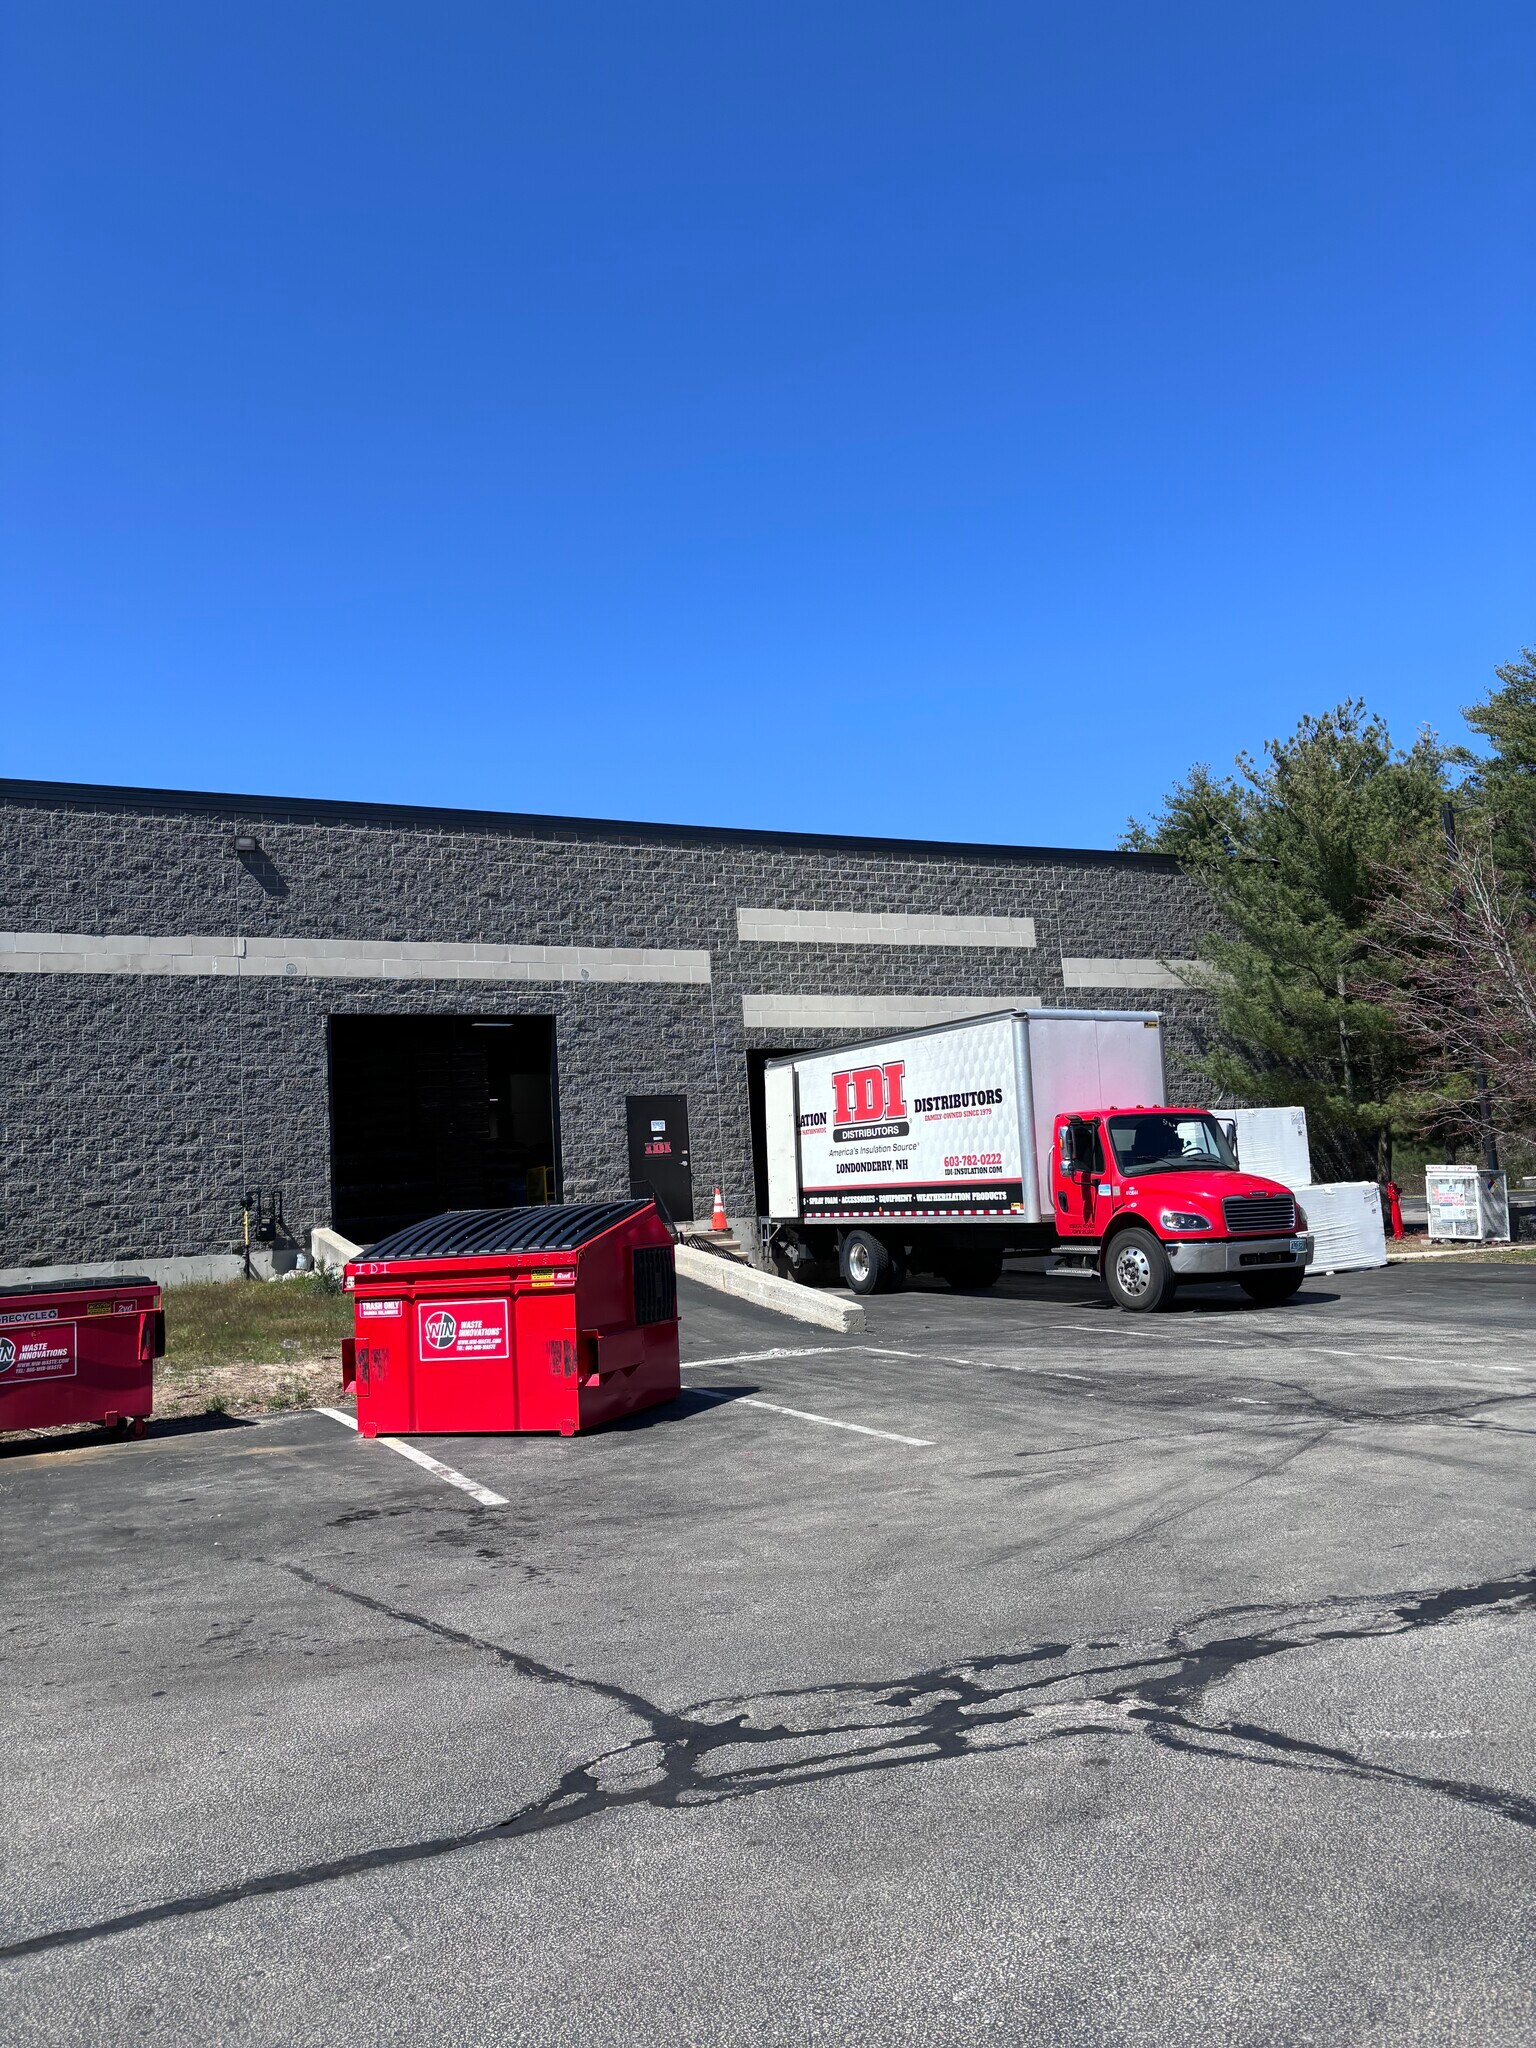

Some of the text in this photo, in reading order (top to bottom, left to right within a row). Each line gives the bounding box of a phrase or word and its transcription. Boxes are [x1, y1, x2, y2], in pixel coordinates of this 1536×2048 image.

[832, 1060, 907, 1126] IDI
[914, 1088, 1002, 1112] DISTRIBUTORS
[963, 1109, 980, 1117] SINCE
[842, 1126, 899, 1139] DISTRIBUTORS
[829, 1147, 859, 1157] America's
[860, 1145, 891, 1153] Insulation
[896, 1159, 909, 1170] NH
[944, 1153, 1002, 1167] 603-782-0222
[879, 1194, 913, 1203] EQUIPMENT
[916, 1193, 971, 1202] WEATHERIZATION
[971, 1191, 1007, 1200] PRODUCTS
[362, 1301, 400, 1311] TRASH ONLY
[2, 1312, 47, 1323] RECYCLE
[461, 1320, 483, 1329] WASTE
[458, 1328, 500, 1337] INNOVATIONS
[22, 1343, 48, 1352] WASTE
[19, 1348, 67, 1360] INNOVATIONS
